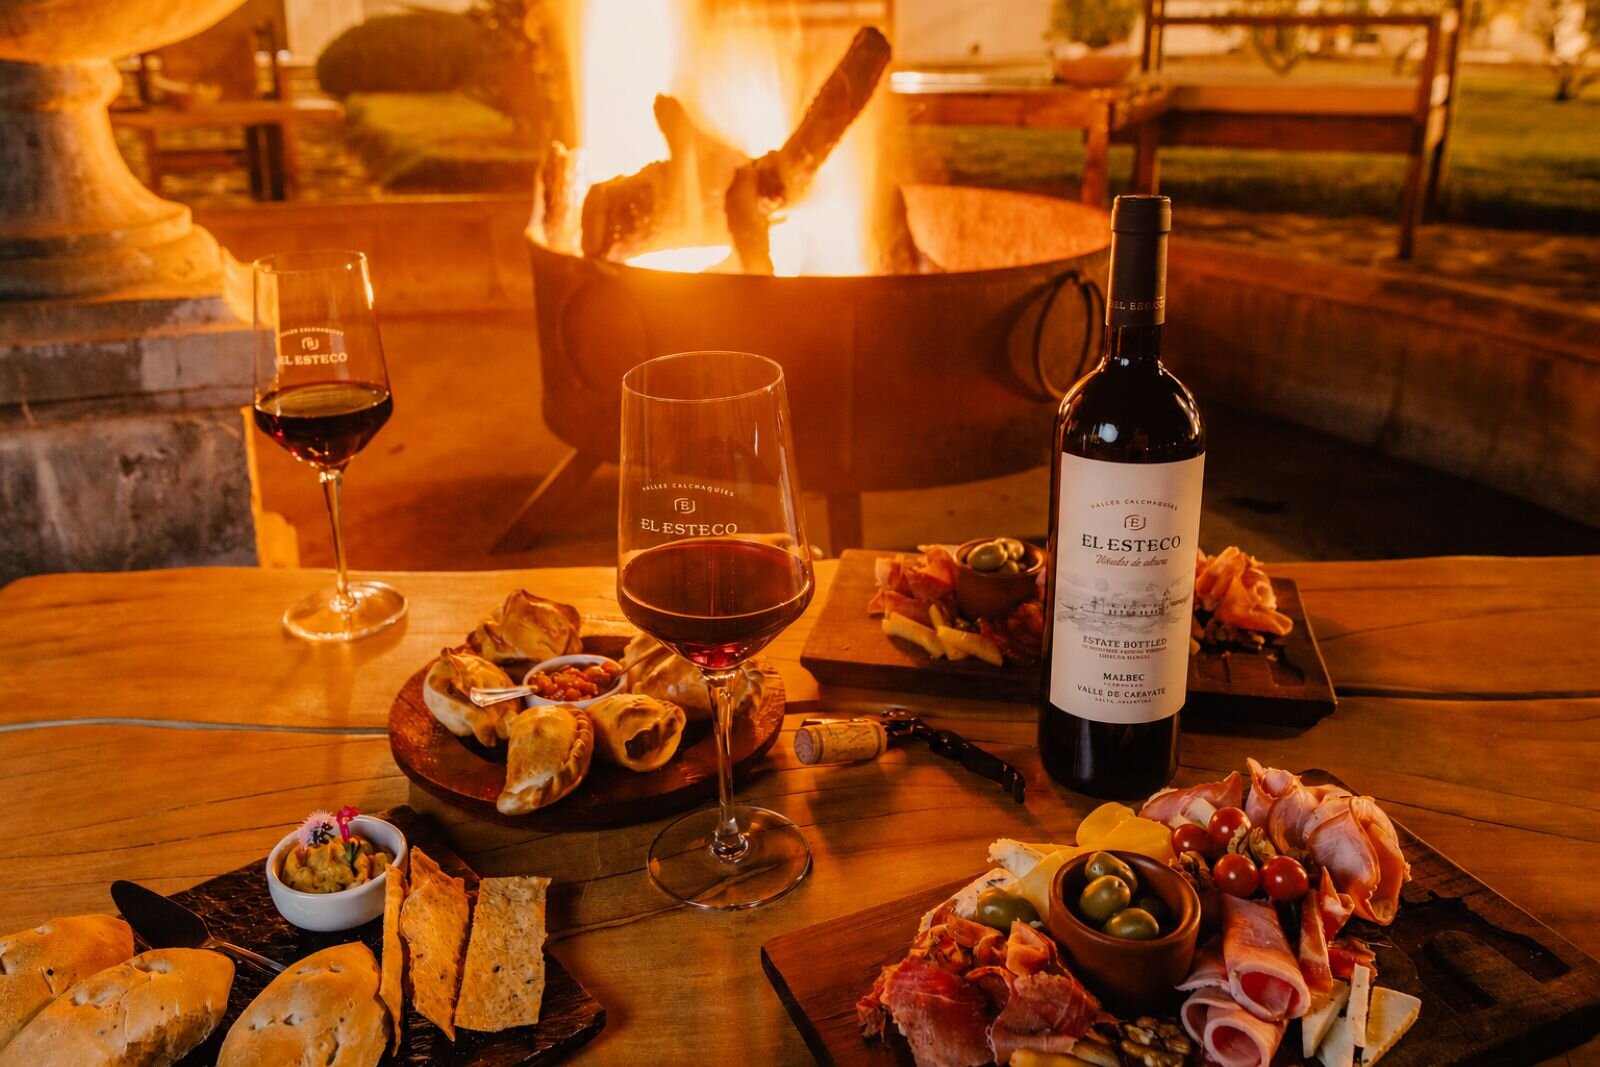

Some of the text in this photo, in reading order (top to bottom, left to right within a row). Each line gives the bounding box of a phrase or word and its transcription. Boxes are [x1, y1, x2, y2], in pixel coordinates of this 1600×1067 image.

[294, 352, 348, 365] ESTECO
[641, 518, 738, 536] EL ESTECO
[1082, 533, 1181, 552] EL ESTECO
[1083, 636, 1121, 648] ESTATE
[1124, 638, 1167, 649] BOTTLED
[1103, 672, 1146, 682] MALBEC
[1077, 684, 1104, 696] VALLE
[1107, 690, 1120, 698] DE
[1124, 687, 1166, 698] CAFAYATE
